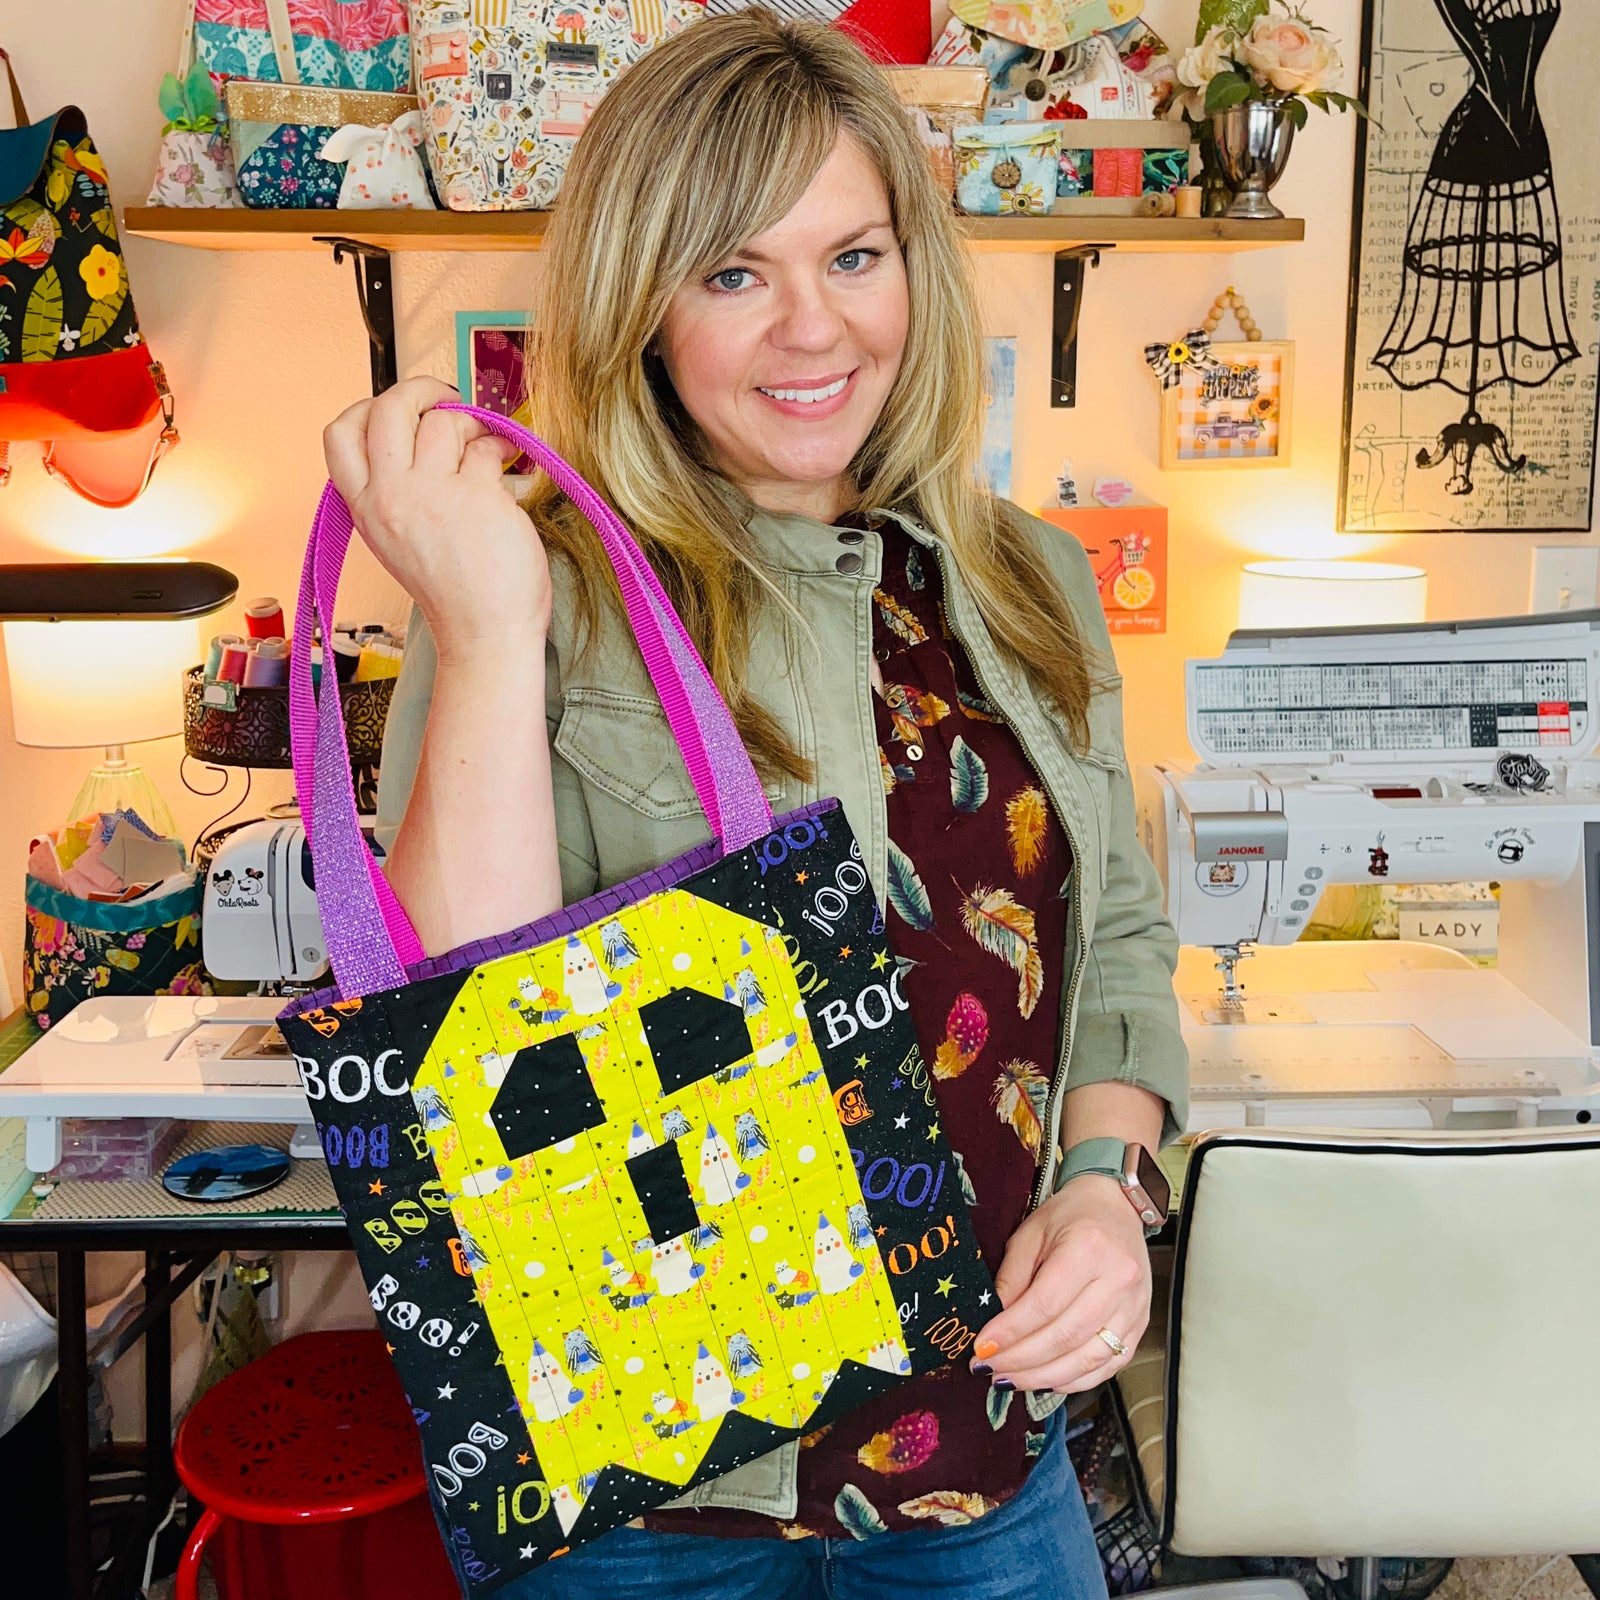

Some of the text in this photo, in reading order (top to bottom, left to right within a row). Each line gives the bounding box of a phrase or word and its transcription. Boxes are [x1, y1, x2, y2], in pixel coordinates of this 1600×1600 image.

[752, 816, 829, 876] OO!
[1217, 846, 1265, 856] JANOME
[1419, 923, 1482, 937] LADY
[369, 1273, 480, 1357] BOO!
